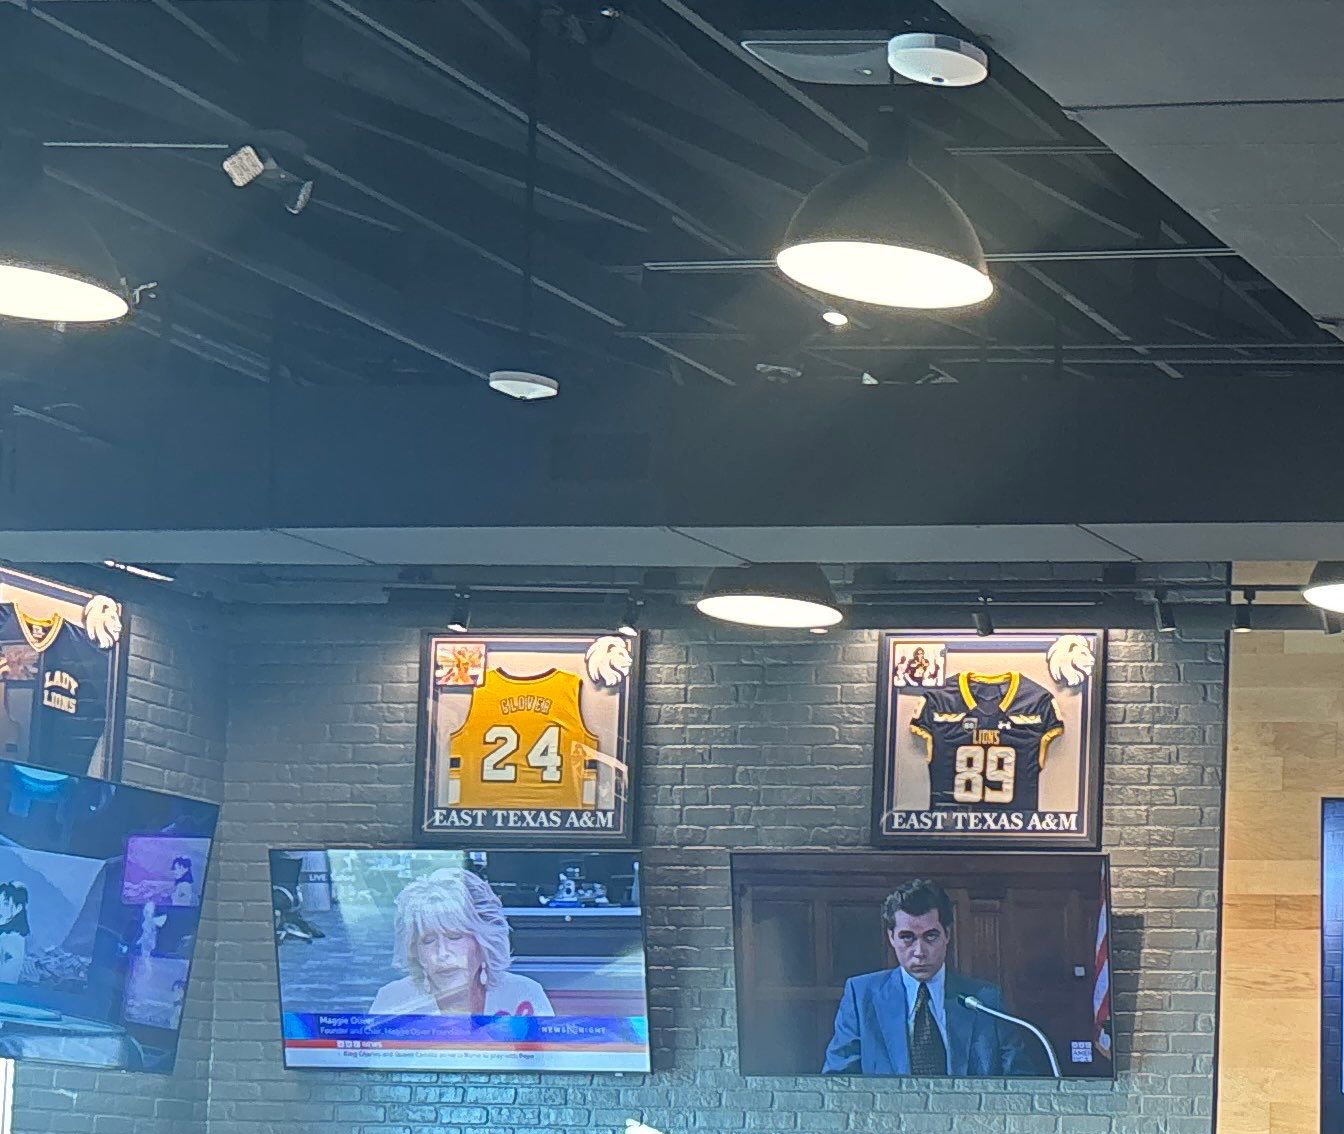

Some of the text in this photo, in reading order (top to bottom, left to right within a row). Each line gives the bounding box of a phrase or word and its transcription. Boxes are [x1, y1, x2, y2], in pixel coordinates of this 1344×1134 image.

[44, 669, 79, 696] LADY
[43, 689, 77, 714] LIONS
[972, 729, 1000, 745] LIONS
[481, 724, 563, 784] 24
[953, 745, 1017, 804] 89
[432, 809, 615, 829] EAST TEXAS A&M
[891, 811, 1078, 831] EAST TEXAS A&M
